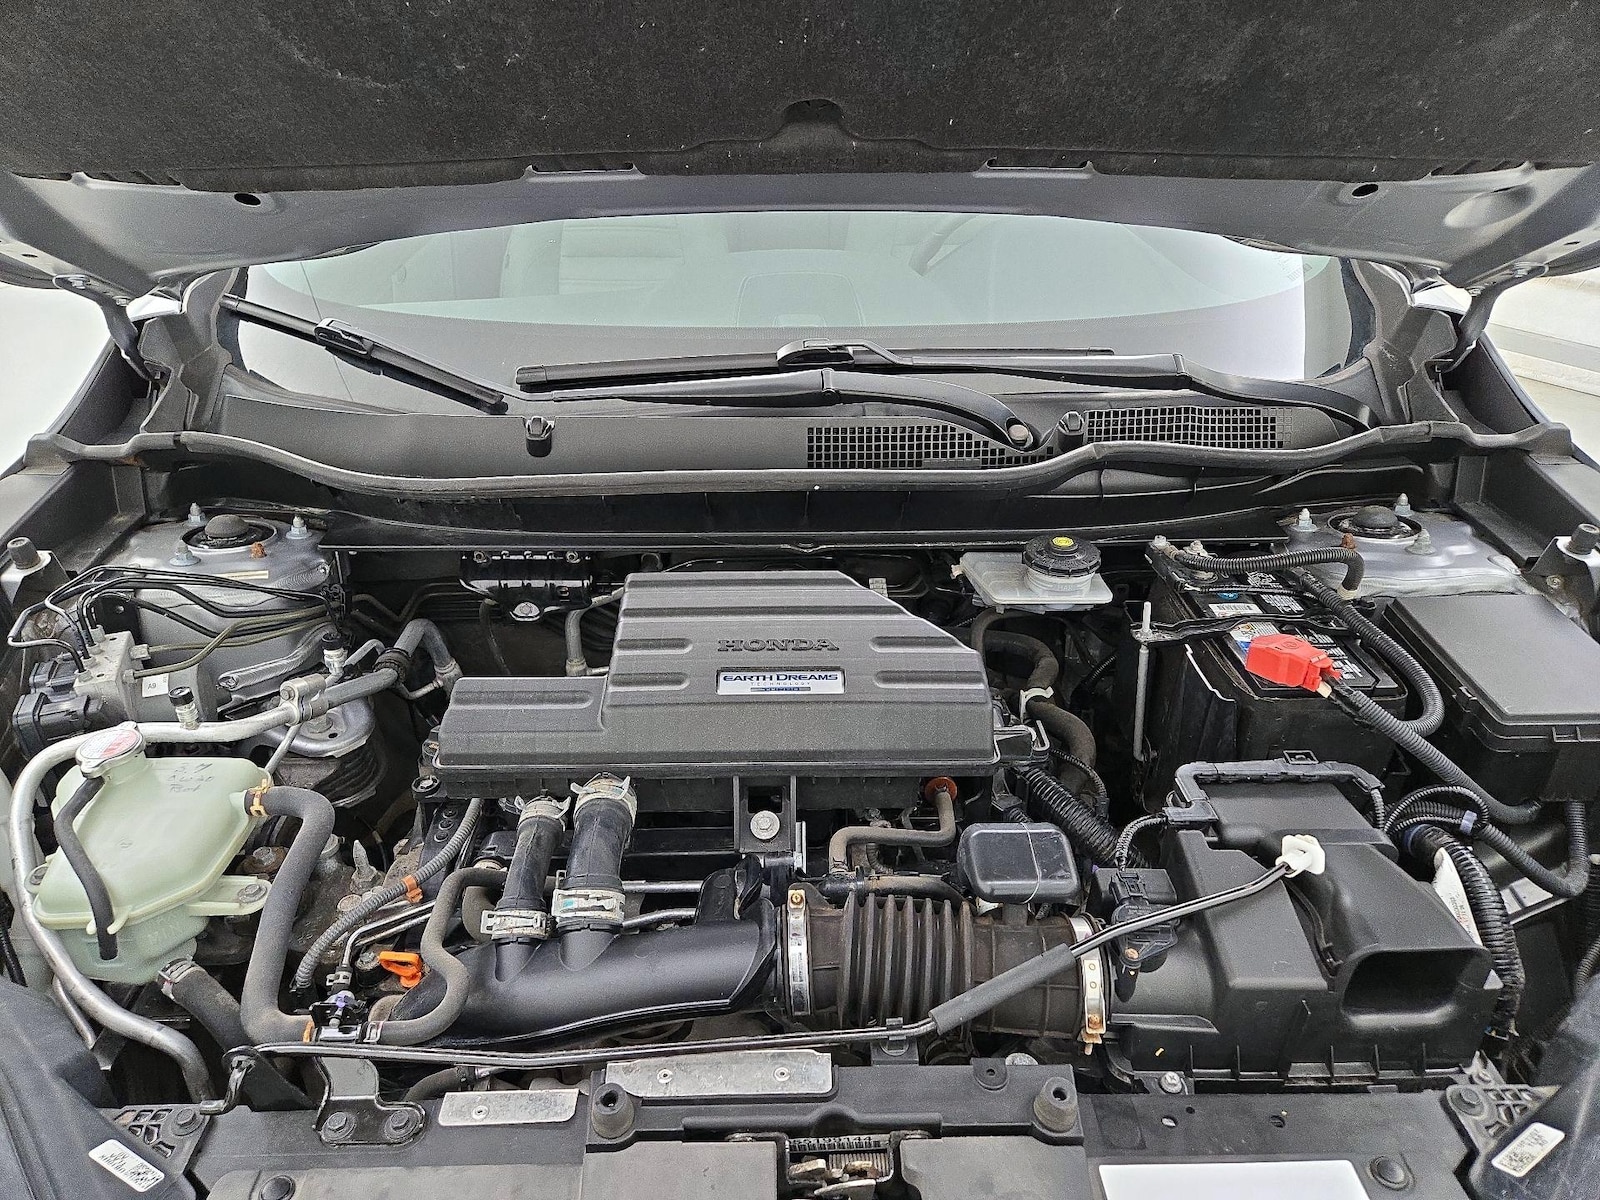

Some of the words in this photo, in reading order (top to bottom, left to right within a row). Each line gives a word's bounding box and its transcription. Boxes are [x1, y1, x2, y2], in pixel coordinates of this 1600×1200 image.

[718, 638, 839, 652] HONDA
[723, 674, 774, 682] EARTH
[776, 673, 838, 681] DREAMS
